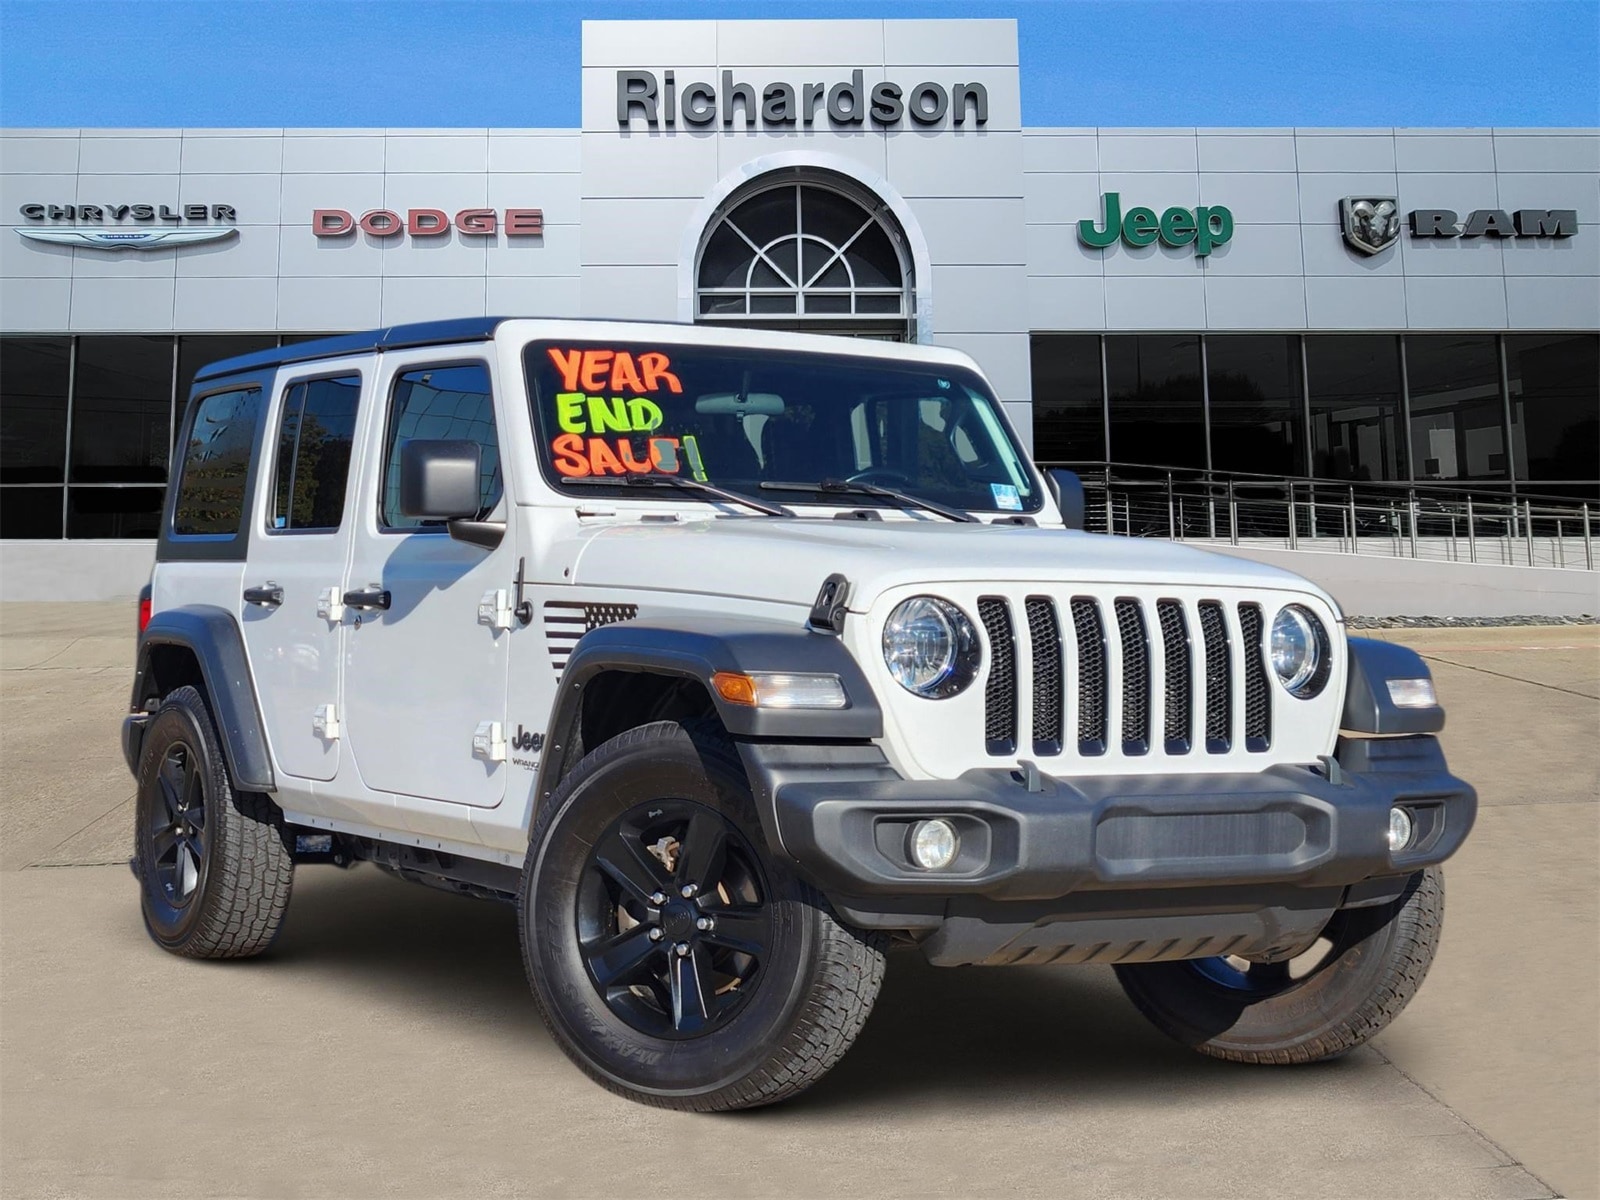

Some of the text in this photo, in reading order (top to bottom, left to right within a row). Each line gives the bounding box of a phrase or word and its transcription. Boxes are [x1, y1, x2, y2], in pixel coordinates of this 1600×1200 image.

[616, 69, 989, 126] Richardson
[19, 203, 237, 221] CHRYSLER
[312, 208, 544, 237] DODGE
[1077, 192, 1235, 257] Jeep
[1408, 209, 1578, 238] RAM
[548, 348, 683, 393] YEAR
[556, 392, 664, 434] END
